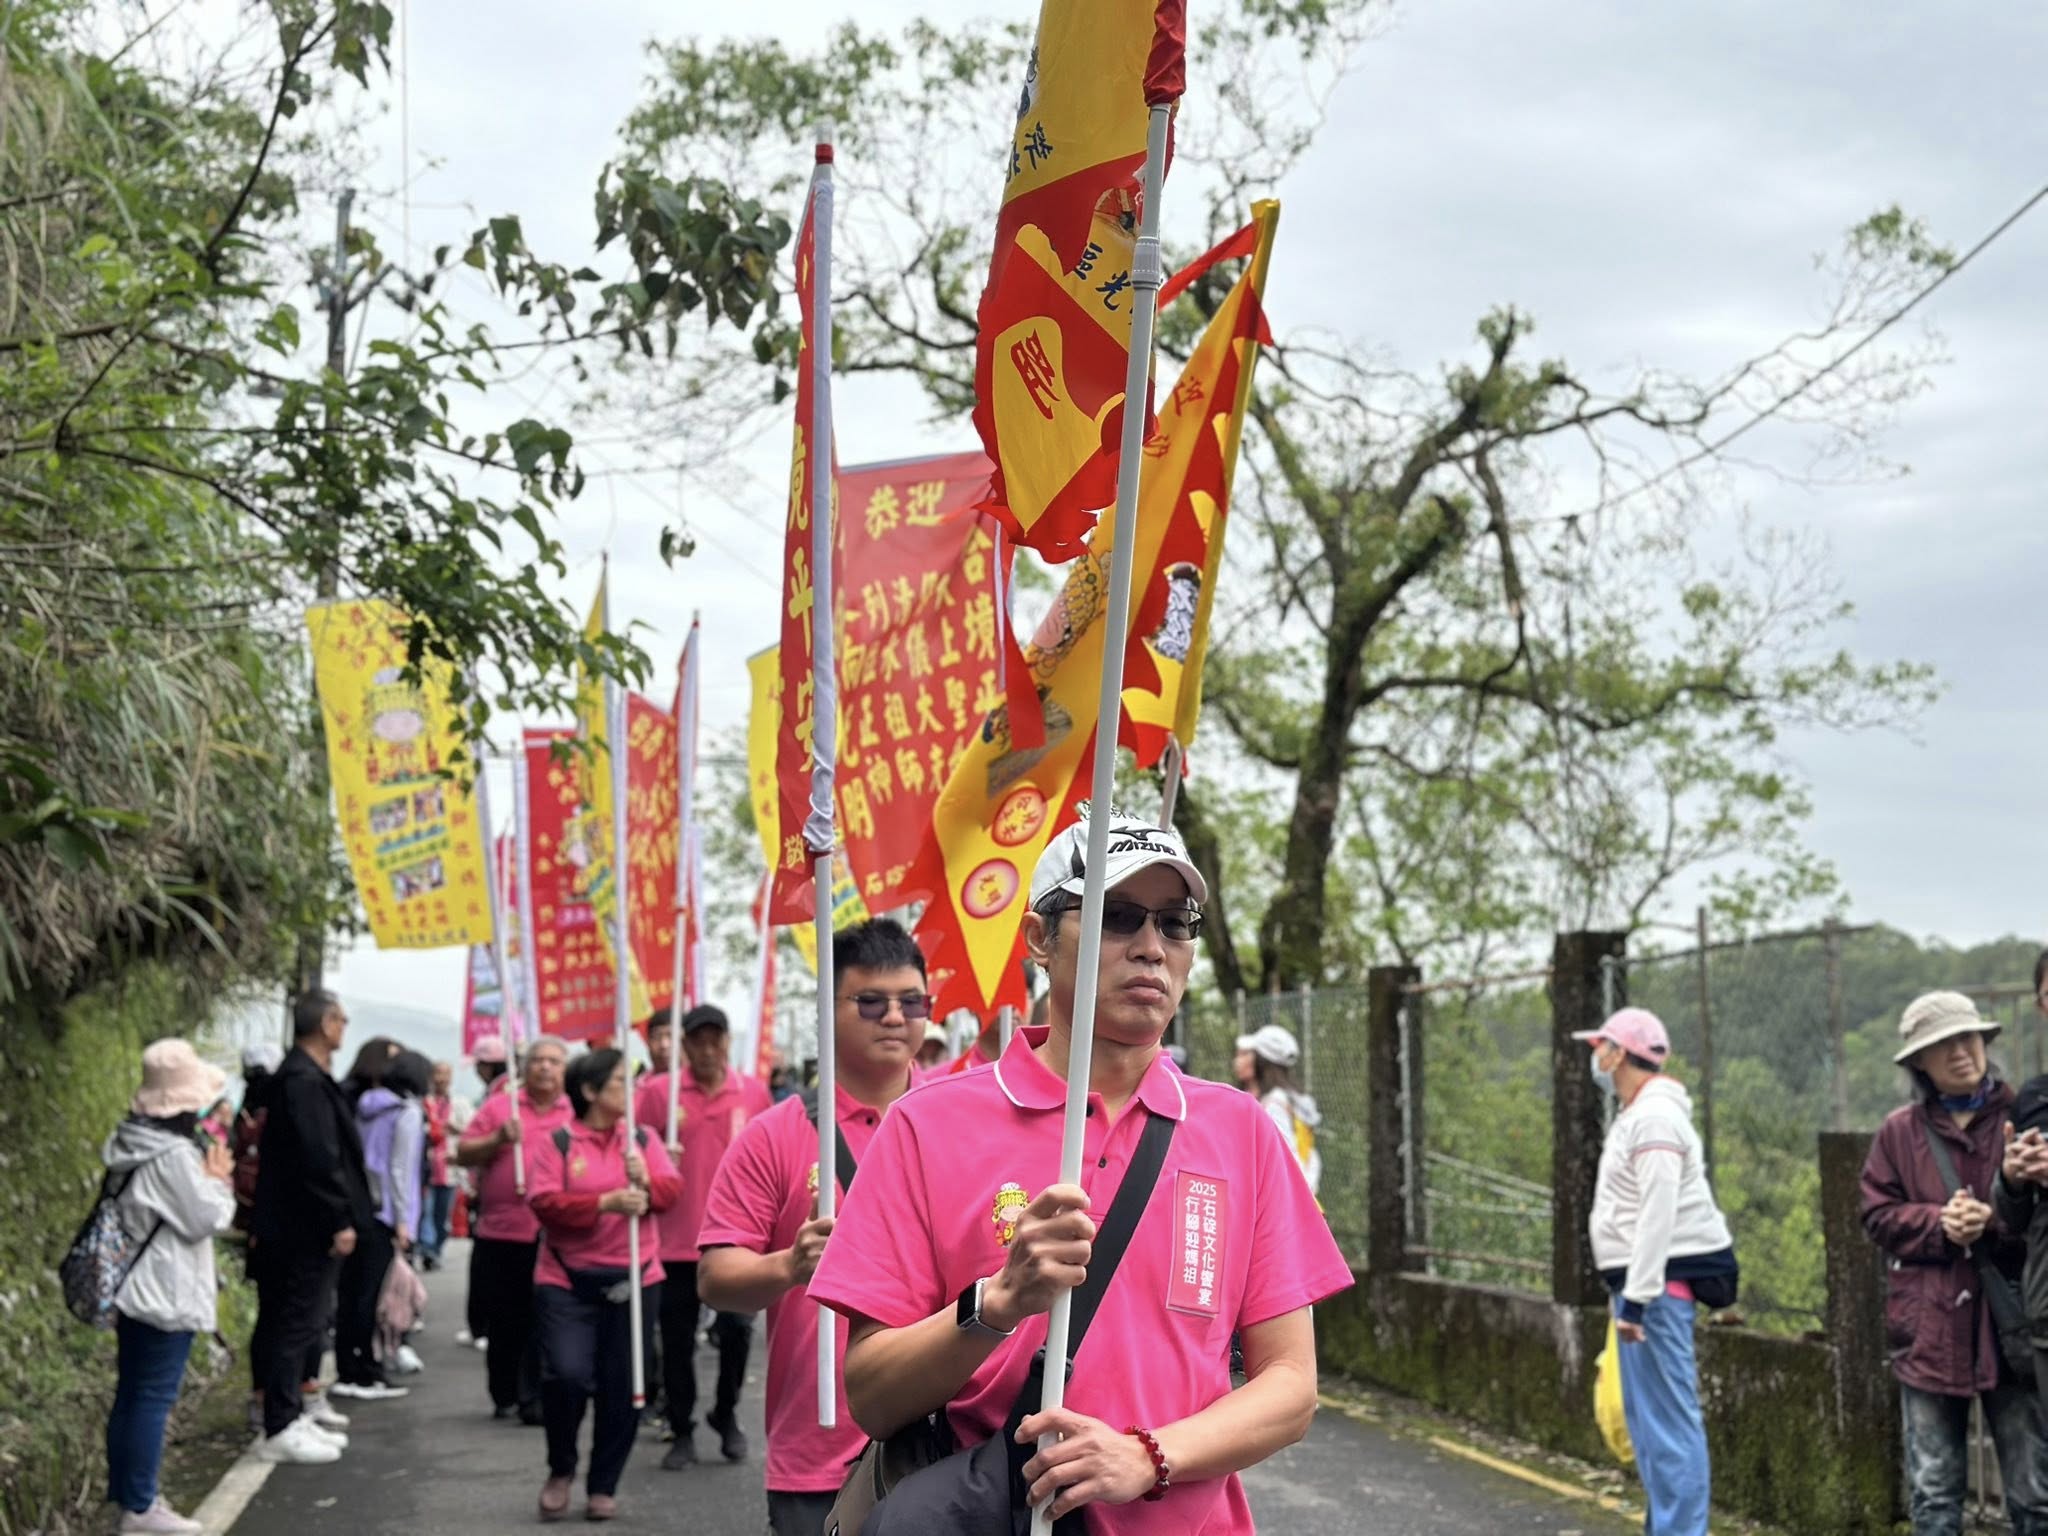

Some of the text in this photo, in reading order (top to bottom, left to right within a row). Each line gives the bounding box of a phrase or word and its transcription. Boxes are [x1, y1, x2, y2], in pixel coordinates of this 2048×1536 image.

[865, 480, 945, 541] 恭迎
[1189, 1180, 1217, 1196] 2025
[1183, 1197, 1200, 1285] 行腳迎媽祖
[1198, 1199, 1217, 1306] 石碇文化饗宴
